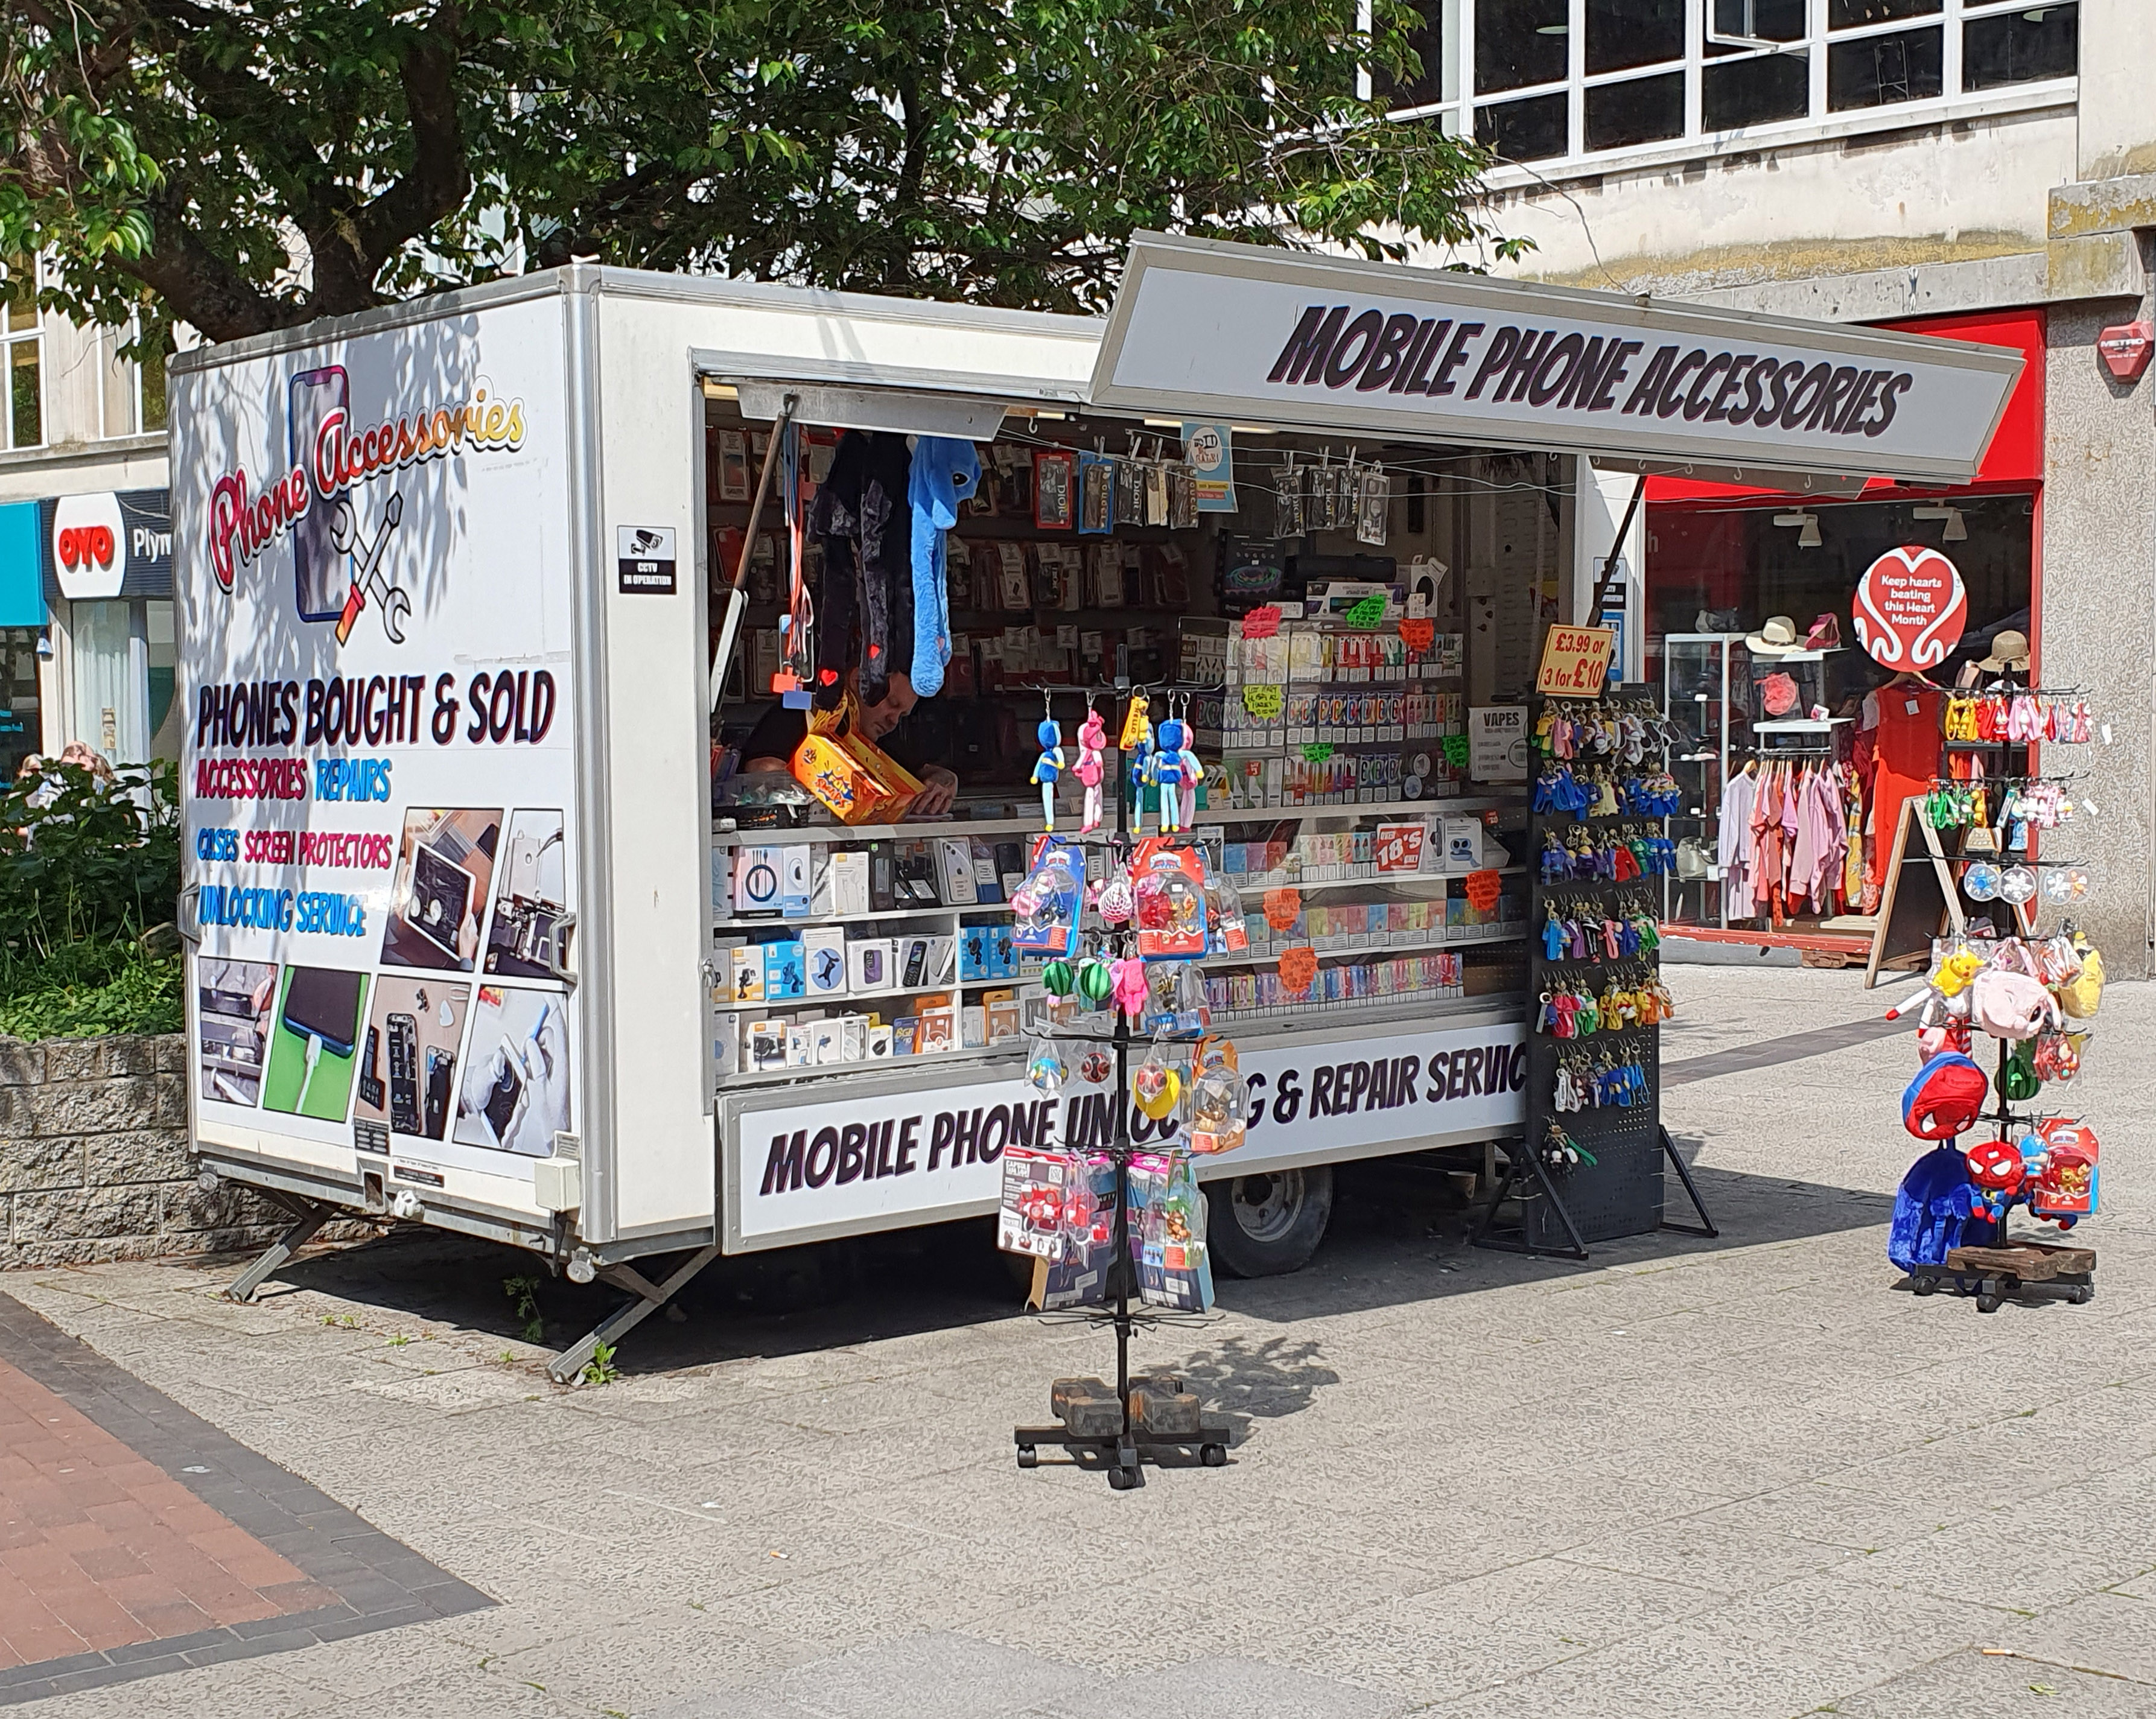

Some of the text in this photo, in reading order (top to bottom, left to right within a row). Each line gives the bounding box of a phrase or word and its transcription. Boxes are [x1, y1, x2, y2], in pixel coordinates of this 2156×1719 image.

[1266, 305, 1913, 438] MOBILE PHONE ACCESSORIES
[209, 387, 523, 599] Phone Accessories
[624, 574, 672, 585] IN OPERATION
[637, 562, 658, 573] CCTV
[1881, 575, 1942, 588] Keep hearts
[1884, 601, 1935, 613] this Heart
[1890, 588, 1931, 603] beating
[1892, 614, 1927, 626] Month
[1555, 633, 1605, 654] £3.99 or
[1544, 658, 1603, 688] 3 for £10
[197, 679, 298, 749] PHONES
[304, 673, 425, 747] BOUGHT
[431, 672, 460, 746] &
[467, 669, 556, 745] SOLD
[1483, 712, 1520, 726] VAPES
[196, 758, 393, 802] ACCESSORIES REPAIRS
[197, 827, 393, 869] CASES SCREEN PROTECTORS
[1377, 830, 1422, 867] 18'S
[198, 885, 368, 937] UNLOCKING SERVICE
[759, 1115, 923, 1196] MOBILE
[927, 1098, 1059, 1172] PHONE
[1272, 1069, 1303, 1124] &
[1311, 1054, 1420, 1115] REPAIR
[1426, 1041, 1527, 1104] SERVIC
